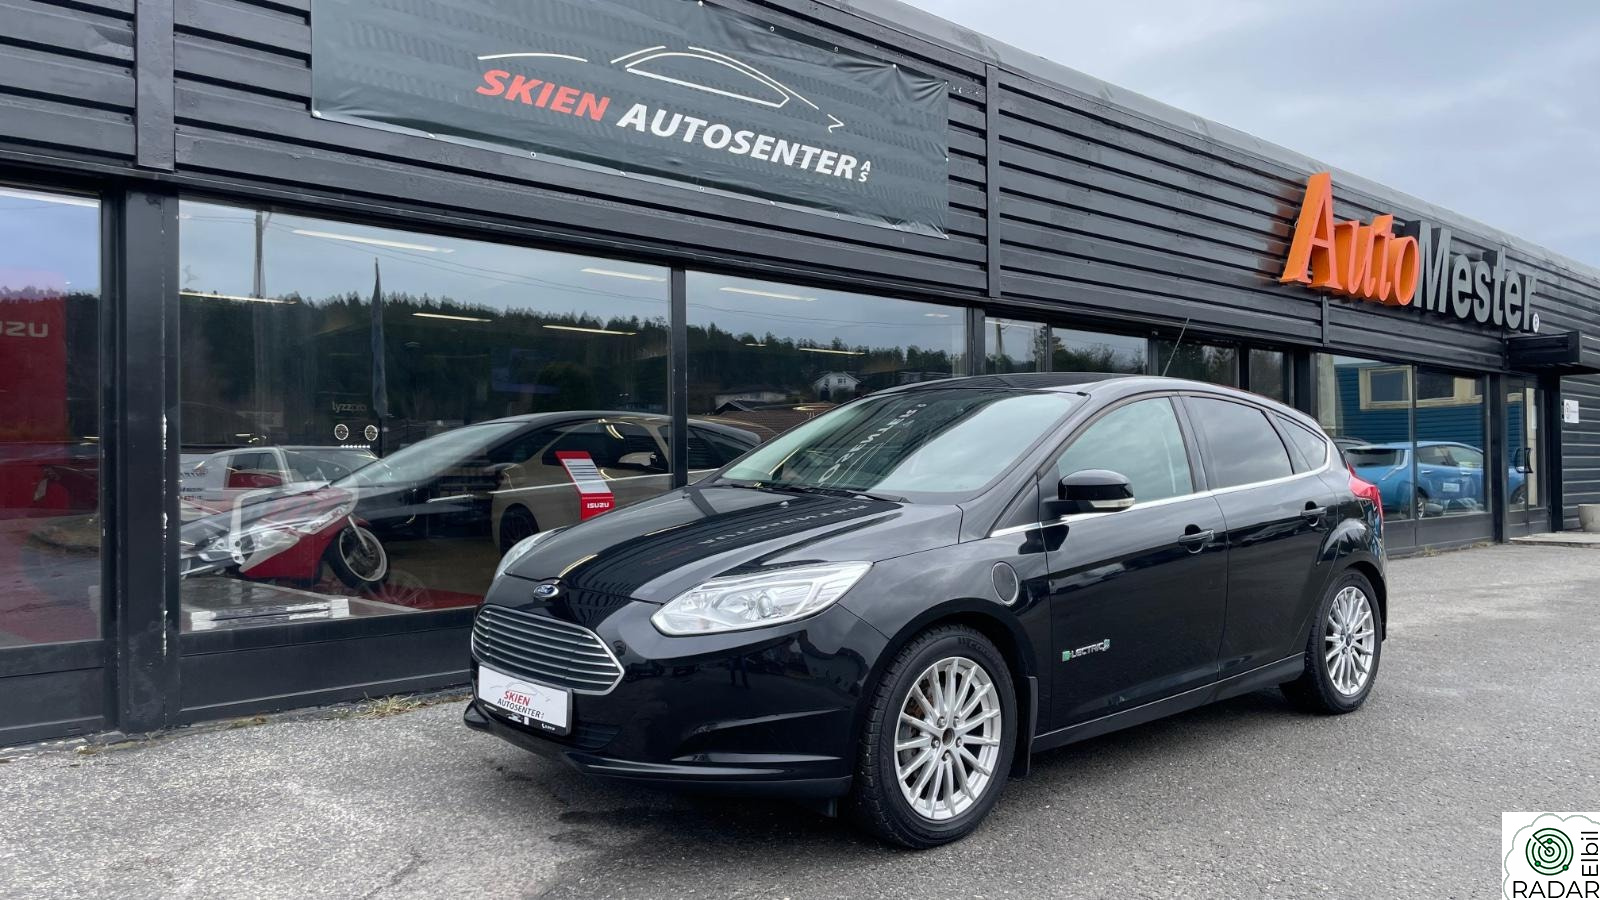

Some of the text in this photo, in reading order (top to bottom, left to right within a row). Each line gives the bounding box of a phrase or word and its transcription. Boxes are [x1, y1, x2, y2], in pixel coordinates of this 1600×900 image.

[475, 69, 611, 122] SKIEN
[616, 103, 858, 180] AUTOSENTER
[0, 320, 49, 338] ZU
[503, 690, 531, 706] SKIEN
[497, 698, 541, 719] AUTOSENTER
